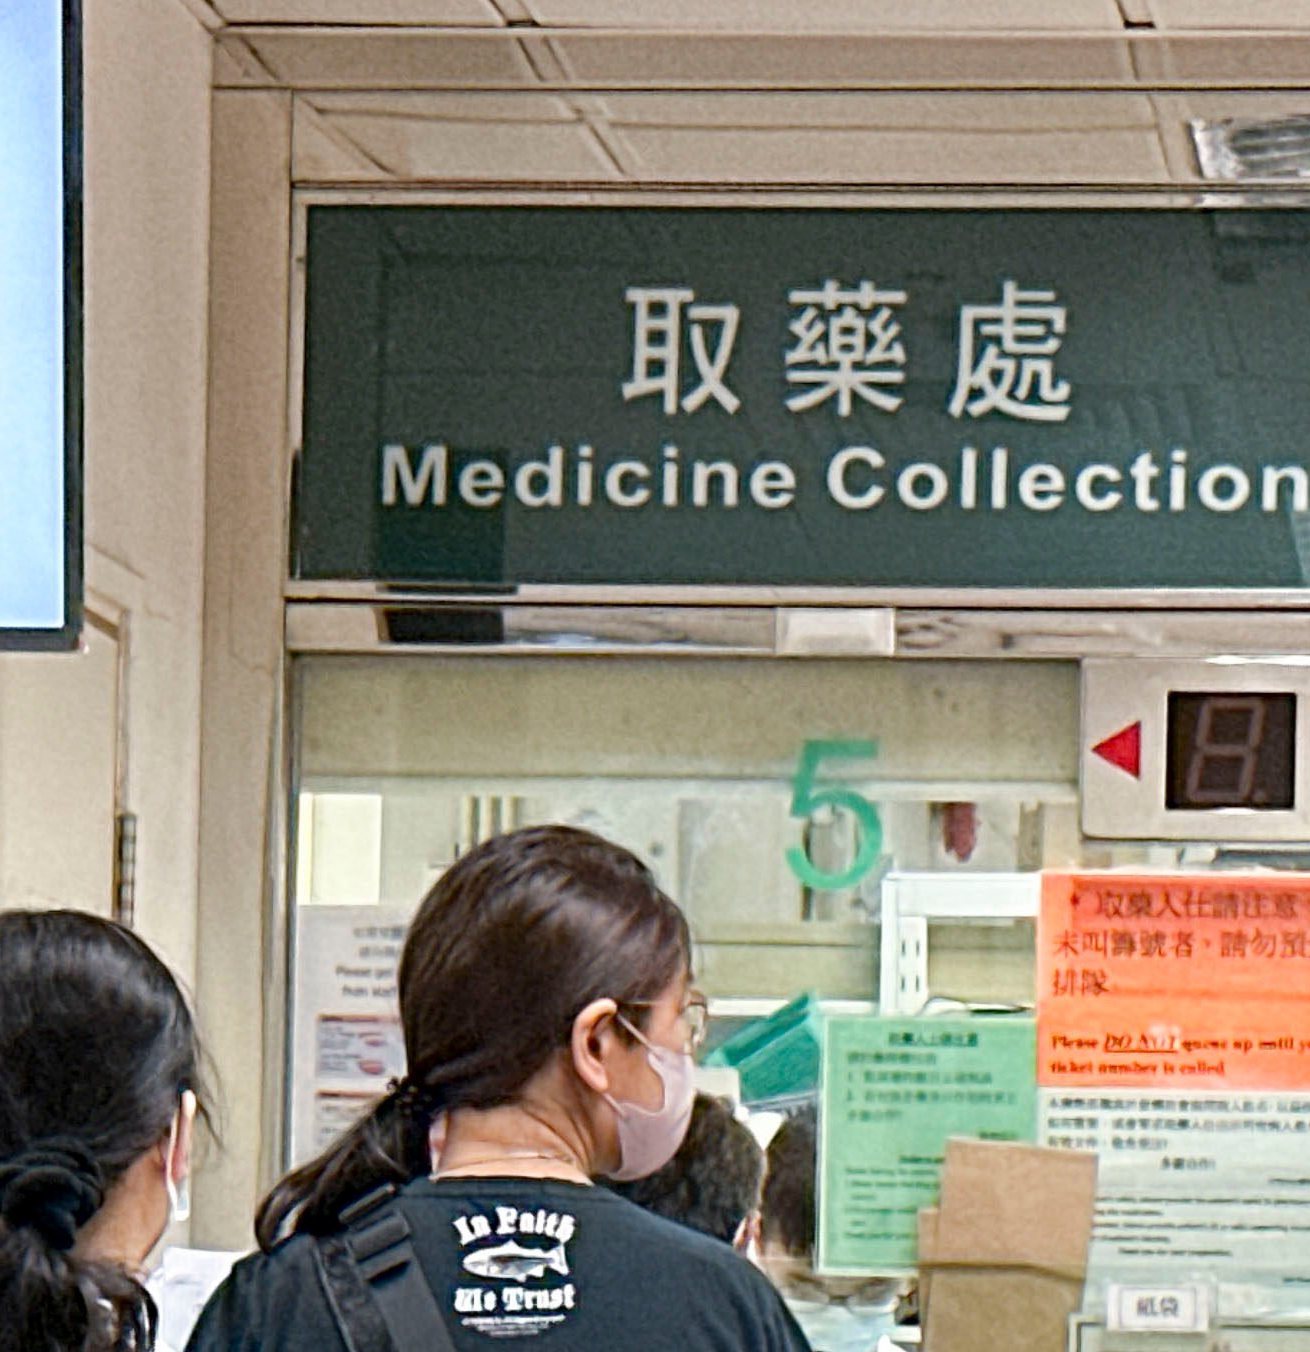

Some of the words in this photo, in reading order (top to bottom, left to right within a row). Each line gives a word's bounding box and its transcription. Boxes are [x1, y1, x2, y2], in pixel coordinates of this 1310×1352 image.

[622, 281, 1071, 421] 取藥處
[383, 445, 796, 510] Medicine
[785, 738, 884, 889] 5
[501, 1283, 577, 1312] Trust
